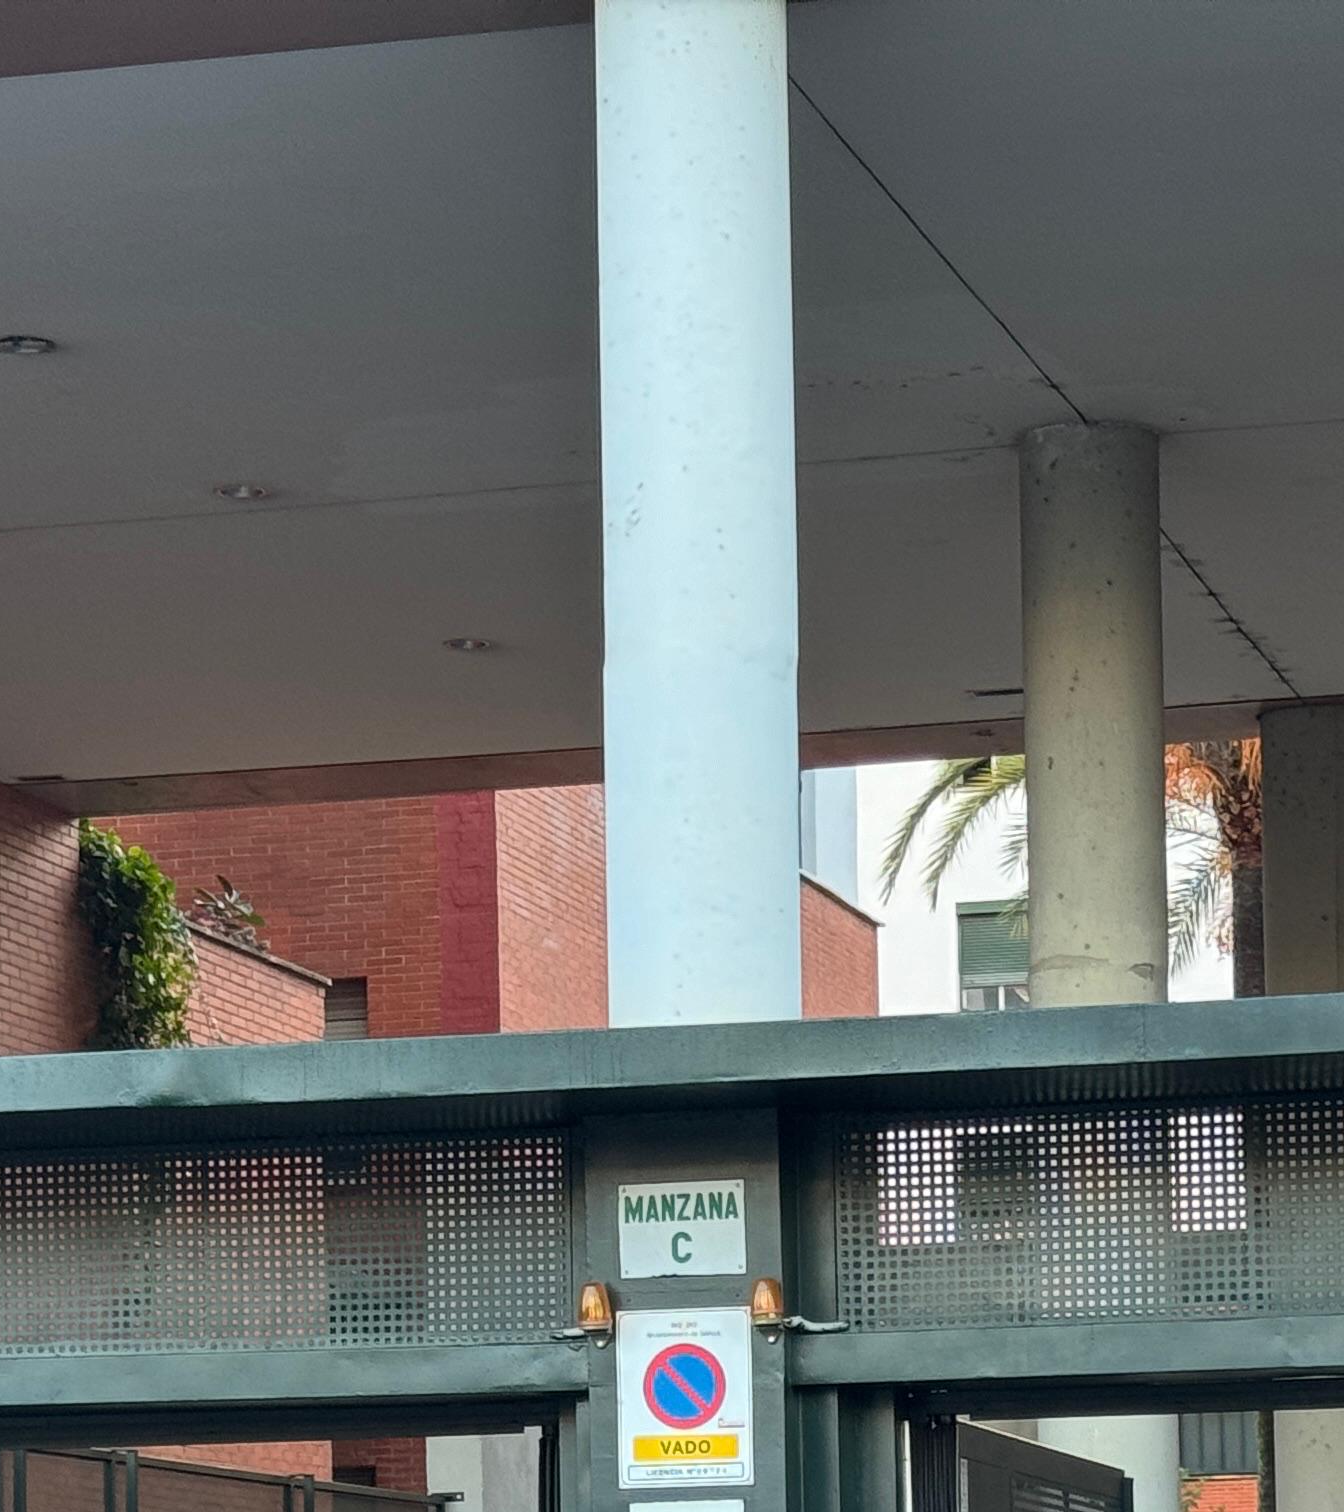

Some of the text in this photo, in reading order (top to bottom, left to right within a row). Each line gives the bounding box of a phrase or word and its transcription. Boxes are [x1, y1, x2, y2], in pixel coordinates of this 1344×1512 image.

[624, 1191, 739, 1224] MANZANA
[671, 1231, 693, 1263] C
[660, 1439, 711, 1455] VADO
